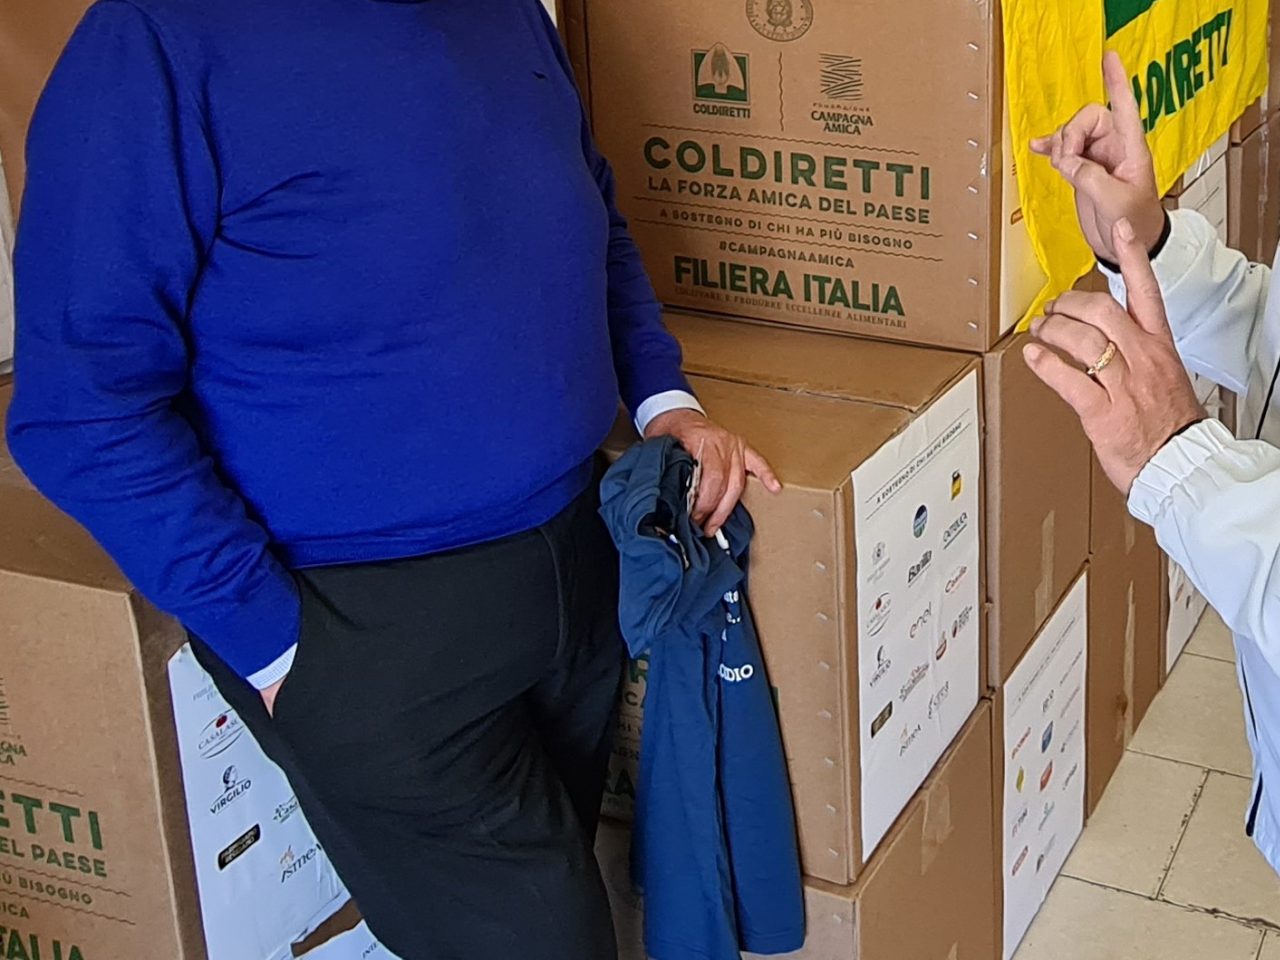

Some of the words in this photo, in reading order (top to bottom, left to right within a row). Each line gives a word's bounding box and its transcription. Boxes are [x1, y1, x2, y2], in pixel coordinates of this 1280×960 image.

[1131, 8, 1233, 134] LDIRETTI
[693, 103, 750, 119] COLDIRETTI
[811, 110, 874, 127] CAMPAGNA
[823, 122, 862, 135] AMICA
[643, 136, 931, 200] COLDIRETTI
[648, 176, 672, 193] LA
[678, 180, 742, 202] FORZA
[748, 188, 812, 210] AMICA
[819, 196, 858, 216] DEL
[864, 202, 930, 224] PAESE
[660, 208, 668, 218] A
[673, 210, 743, 228] SOSTEGNO
[748, 219, 762, 230] DI
[767, 222, 790, 235] CHI
[796, 225, 815, 238] HA
[820, 227, 842, 242] PIÙ
[848, 233, 913, 250] BISOGNO
[719, 240, 855, 269] #CAMPAGNAAMICA
[674, 255, 793, 300] FILIERA
[803, 273, 906, 317] ITALIA
[734, 295, 782, 310] PRODURRE
[785, 301, 842, 318] ECCELLENZE
[846, 312, 907, 328] ALIMENTARI
[210, 779, 252, 815] VIRGILIO
[31, 844, 108, 878] PAESE
[19, 876, 93, 905] BISOGNO
